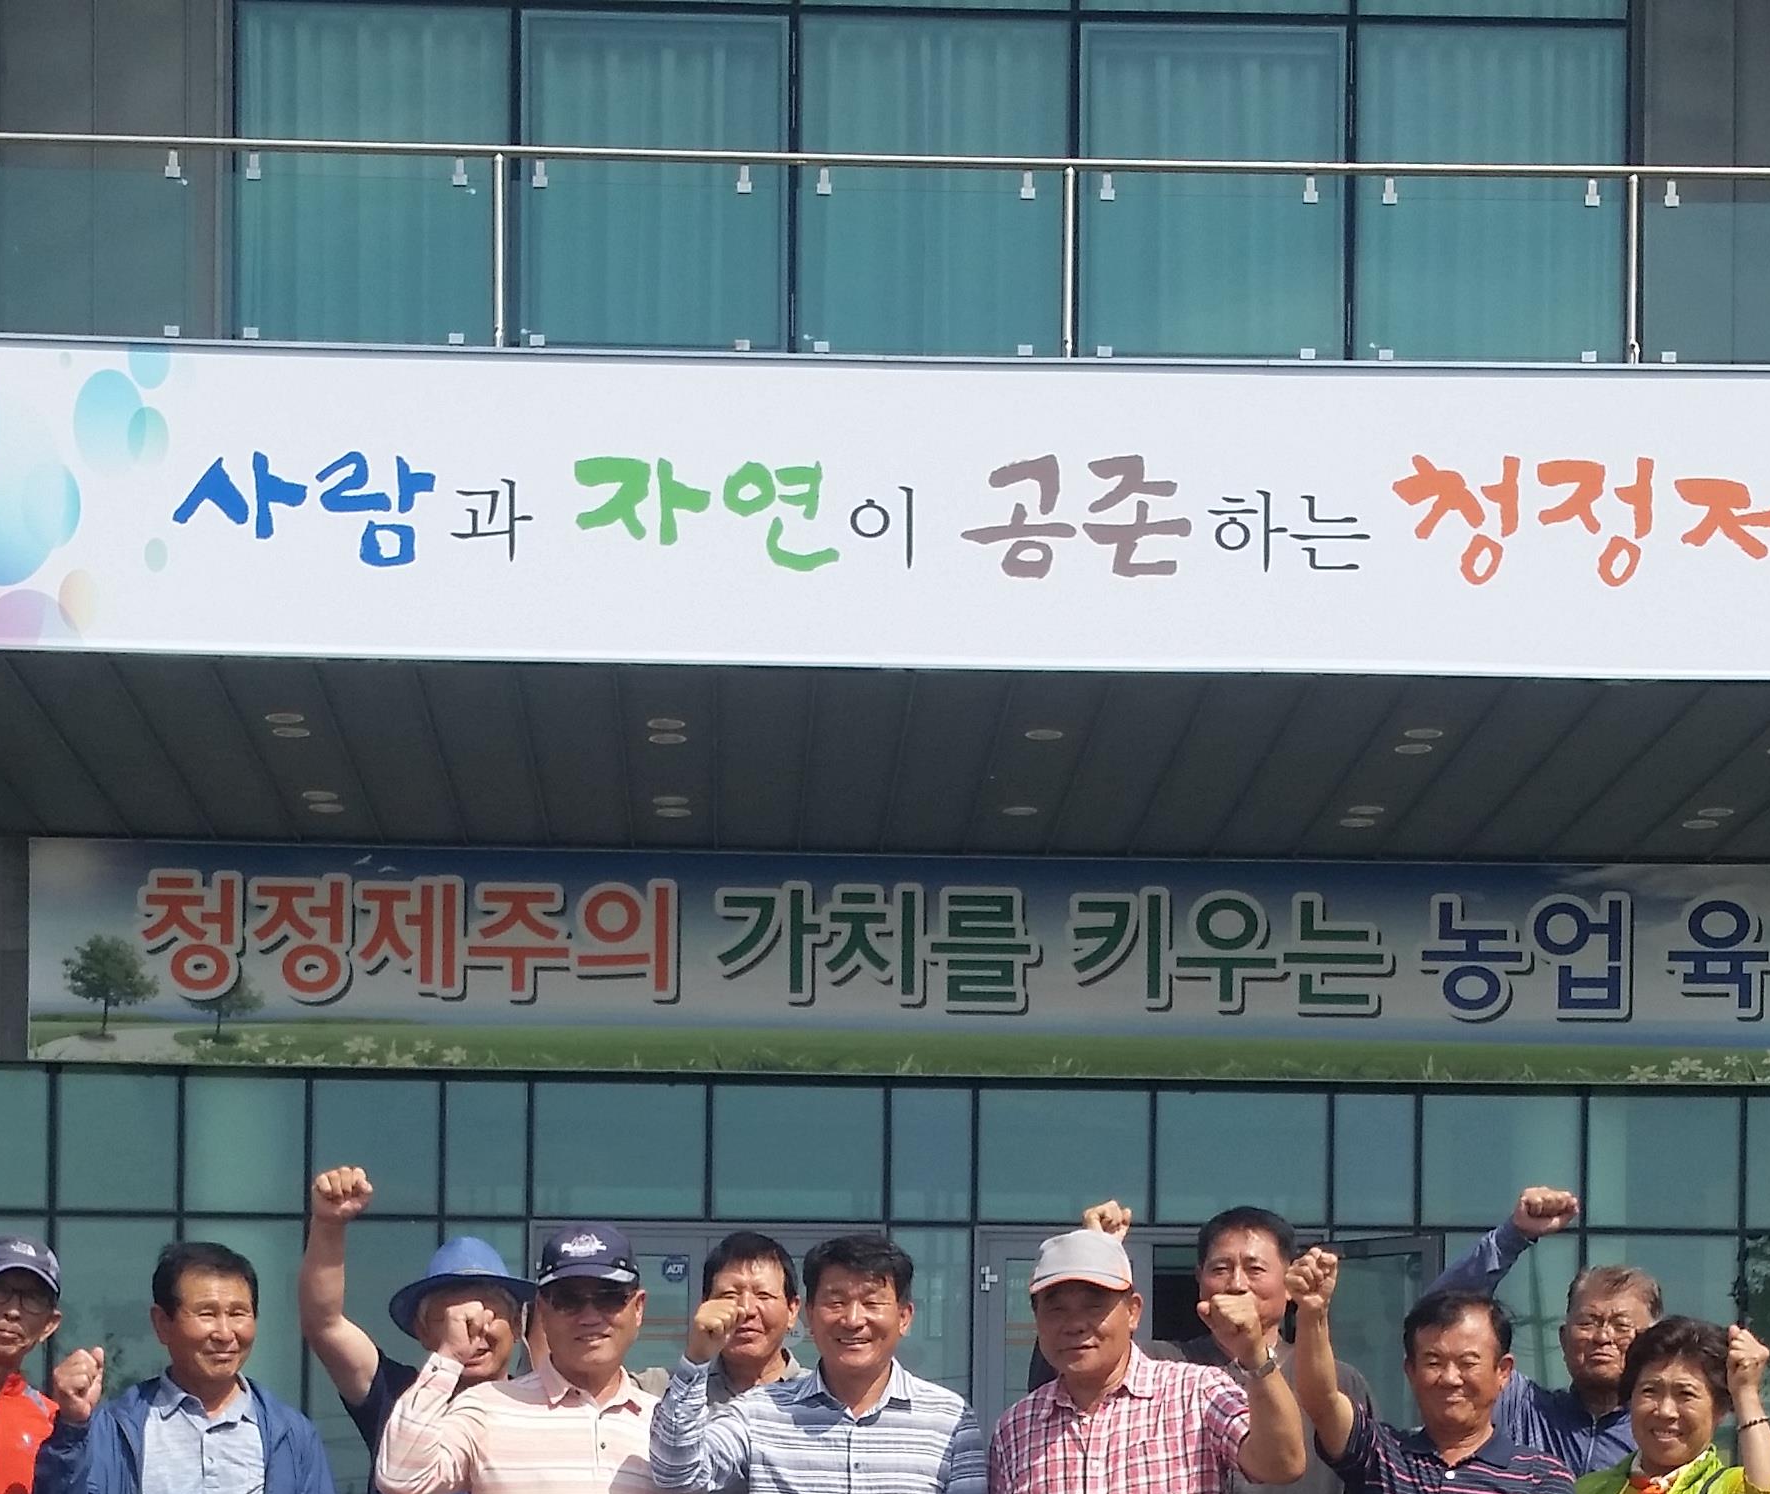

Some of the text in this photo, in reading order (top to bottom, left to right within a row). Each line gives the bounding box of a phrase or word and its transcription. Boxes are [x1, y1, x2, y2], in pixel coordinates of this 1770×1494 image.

[172, 450, 533, 568] 사람과
[573, 456, 915, 572] 자연이
[959, 454, 1370, 578] 공존하는
[141, 876, 671, 994] 청정제주의
[716, 888, 1032, 1004] 가치를
[1072, 893, 1389, 1008] 키우는
[1421, 898, 1623, 1014] 농업
[666, 1263, 685, 1275] ADT
